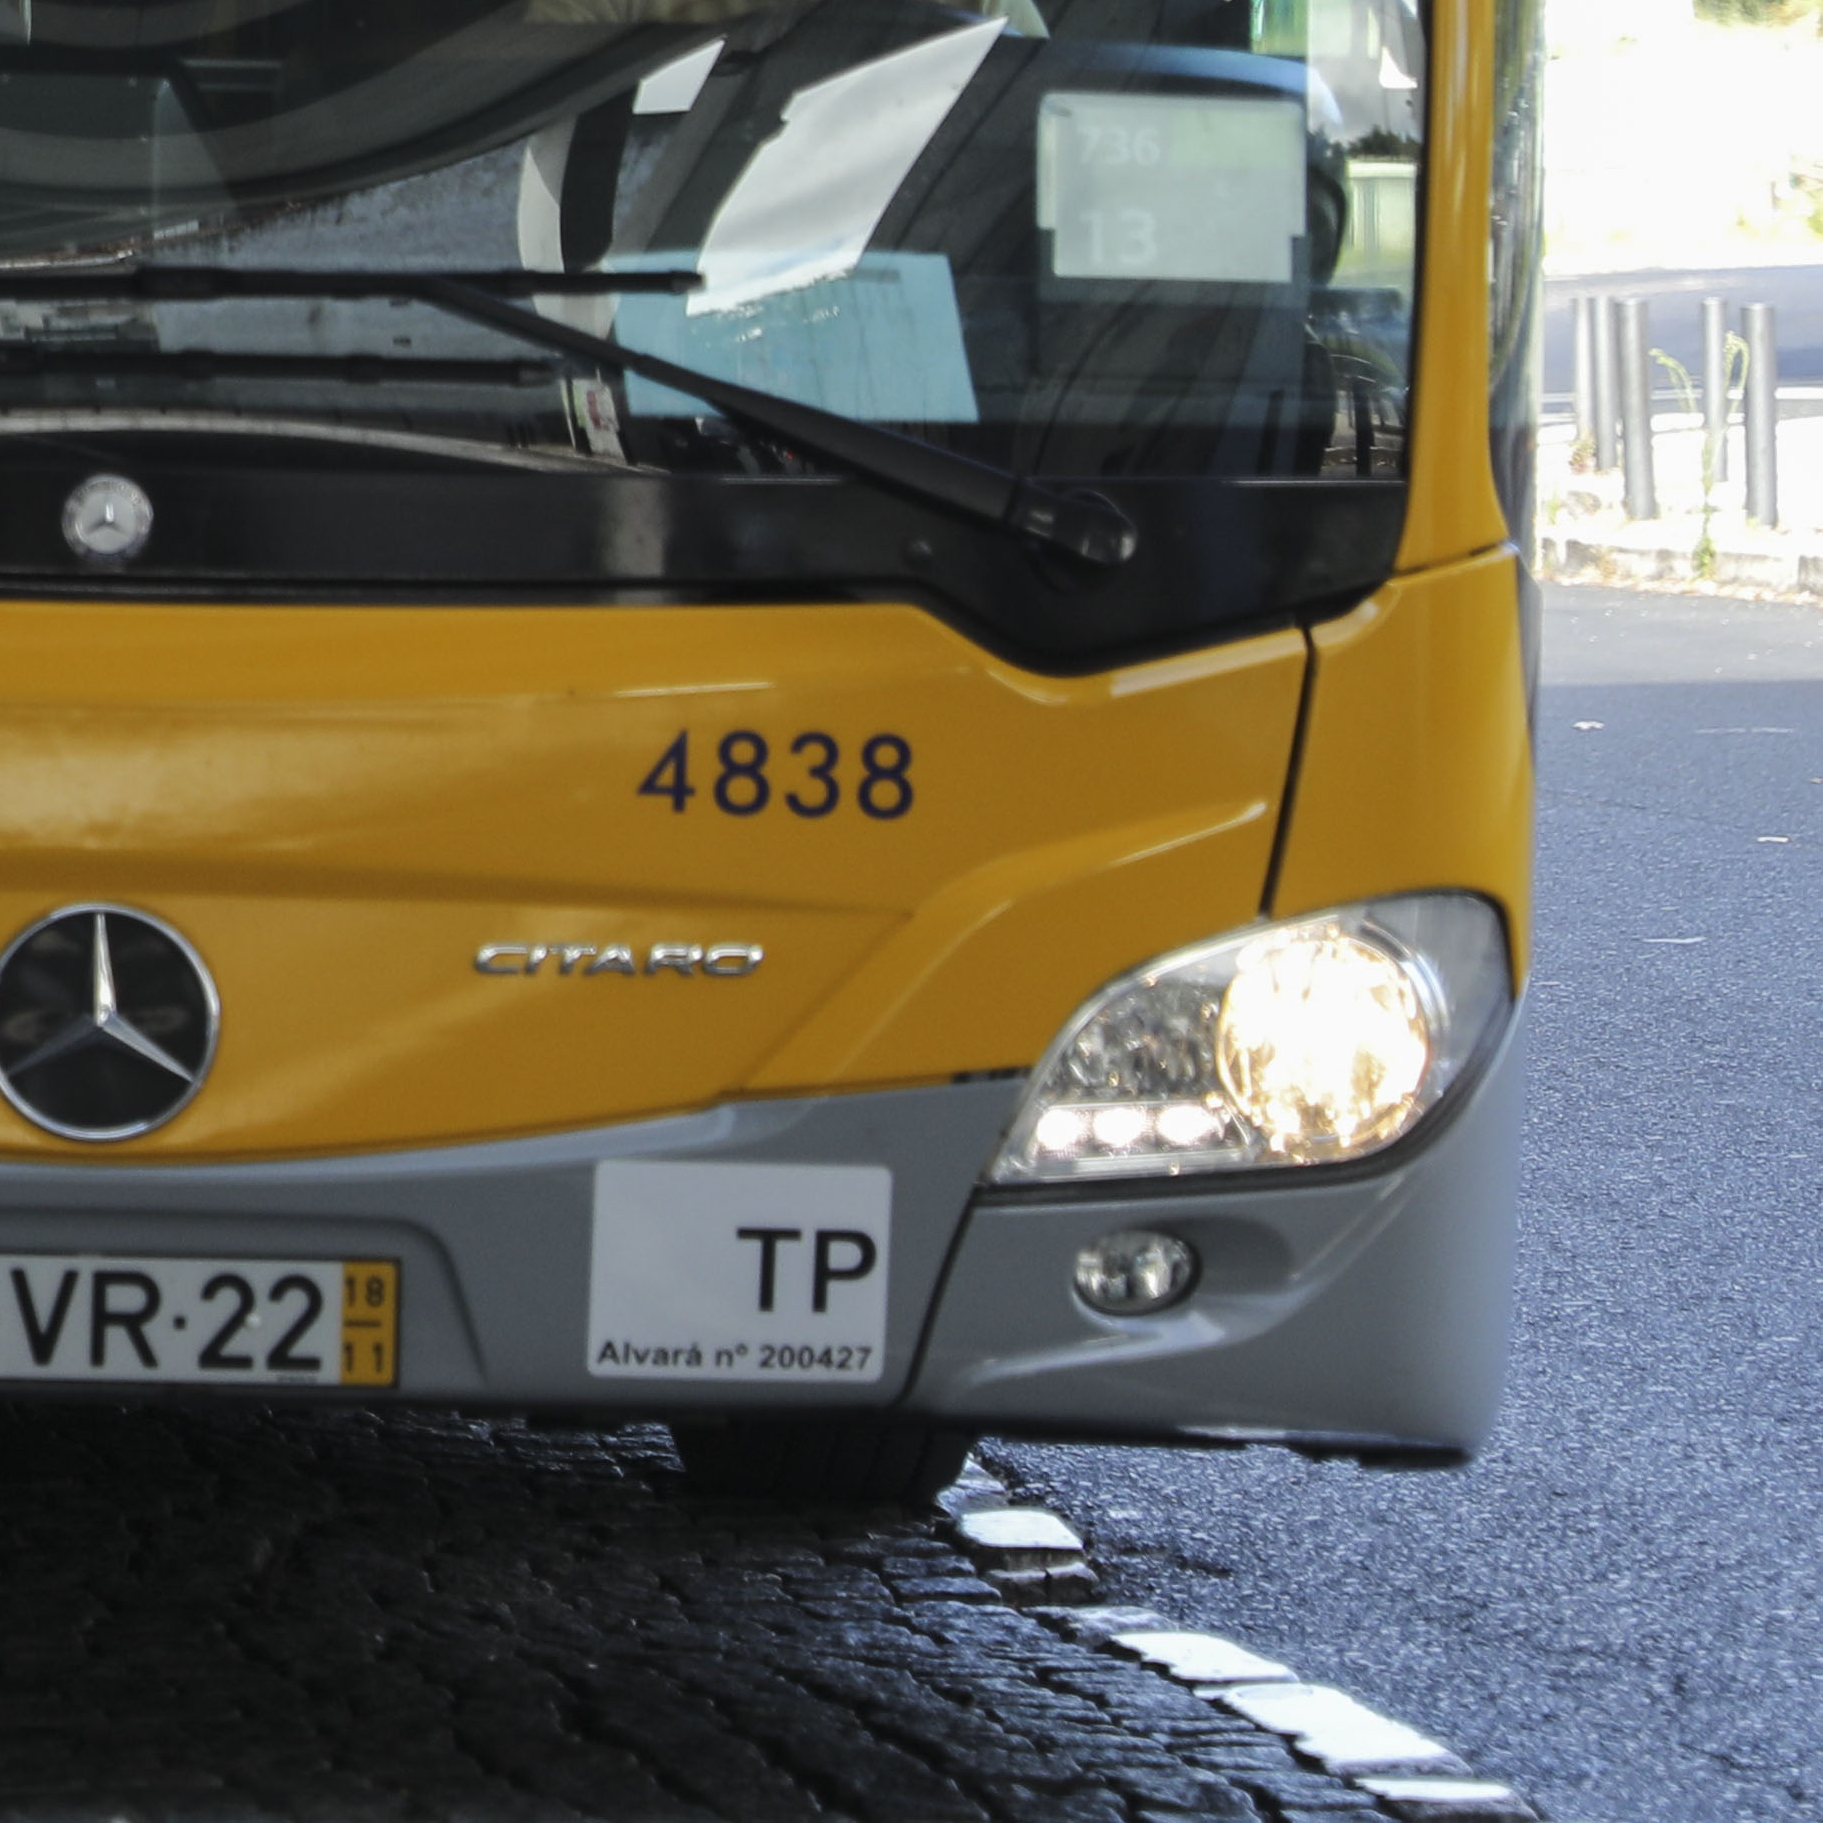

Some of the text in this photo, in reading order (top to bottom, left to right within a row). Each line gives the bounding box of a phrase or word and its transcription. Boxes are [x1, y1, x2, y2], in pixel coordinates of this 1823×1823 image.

[1075, 126, 1162, 167] 736
[1078, 208, 1159, 265] 13
[635, 729, 915, 819] 4838
[474, 940, 764, 976] CITARO
[736, 1227, 877, 1313] TP
[597, 1340, 702, 1367] Alvará
[759, 1344, 873, 1370] 200427
